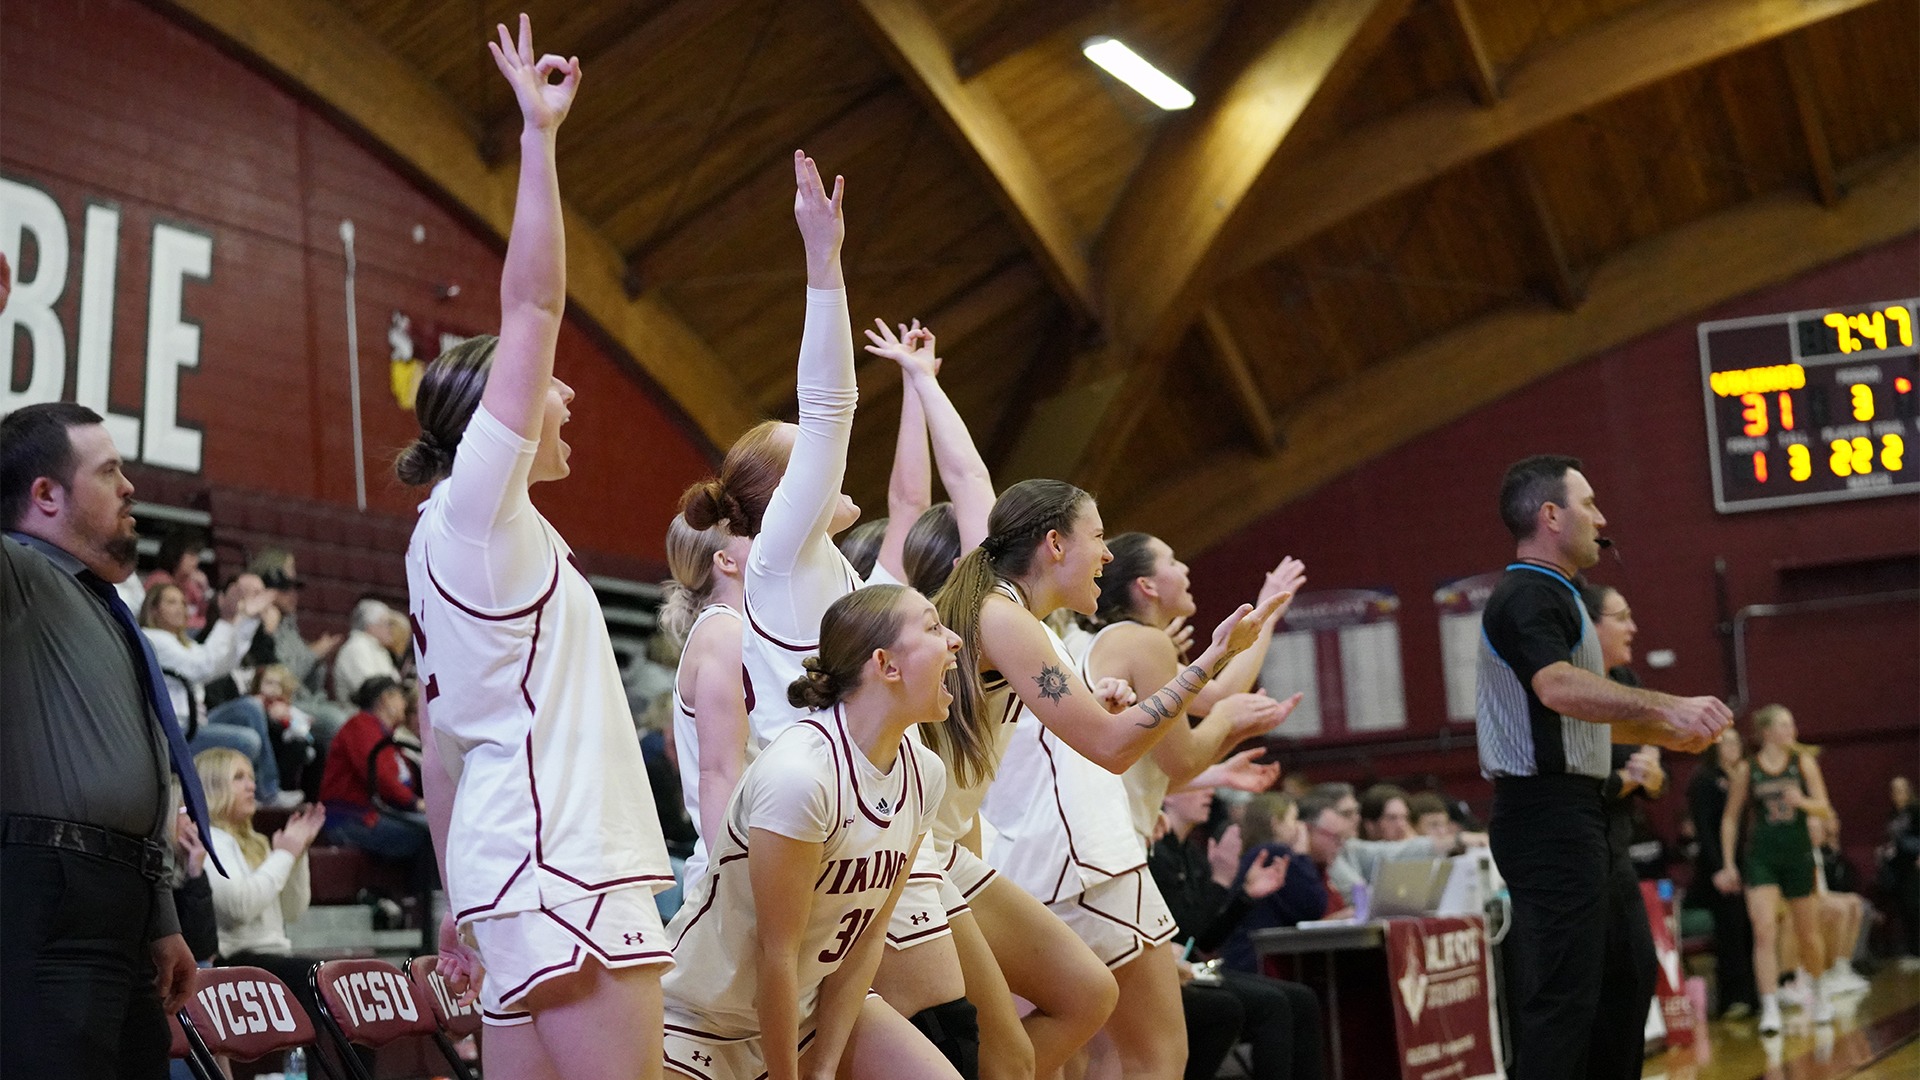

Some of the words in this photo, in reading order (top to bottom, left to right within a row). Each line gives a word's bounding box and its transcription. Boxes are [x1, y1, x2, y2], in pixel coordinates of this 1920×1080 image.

[1823, 306, 1913, 354] 7:47
[1740, 391, 1794, 437] 31
[1850, 383, 1874, 421] 3
[1753, 450, 1768, 483] 1
[1787, 443, 1812, 482] 3
[818, 908, 875, 963] 31
[197, 980, 297, 1041] VCSU
[333, 970, 419, 1028] VCSU
